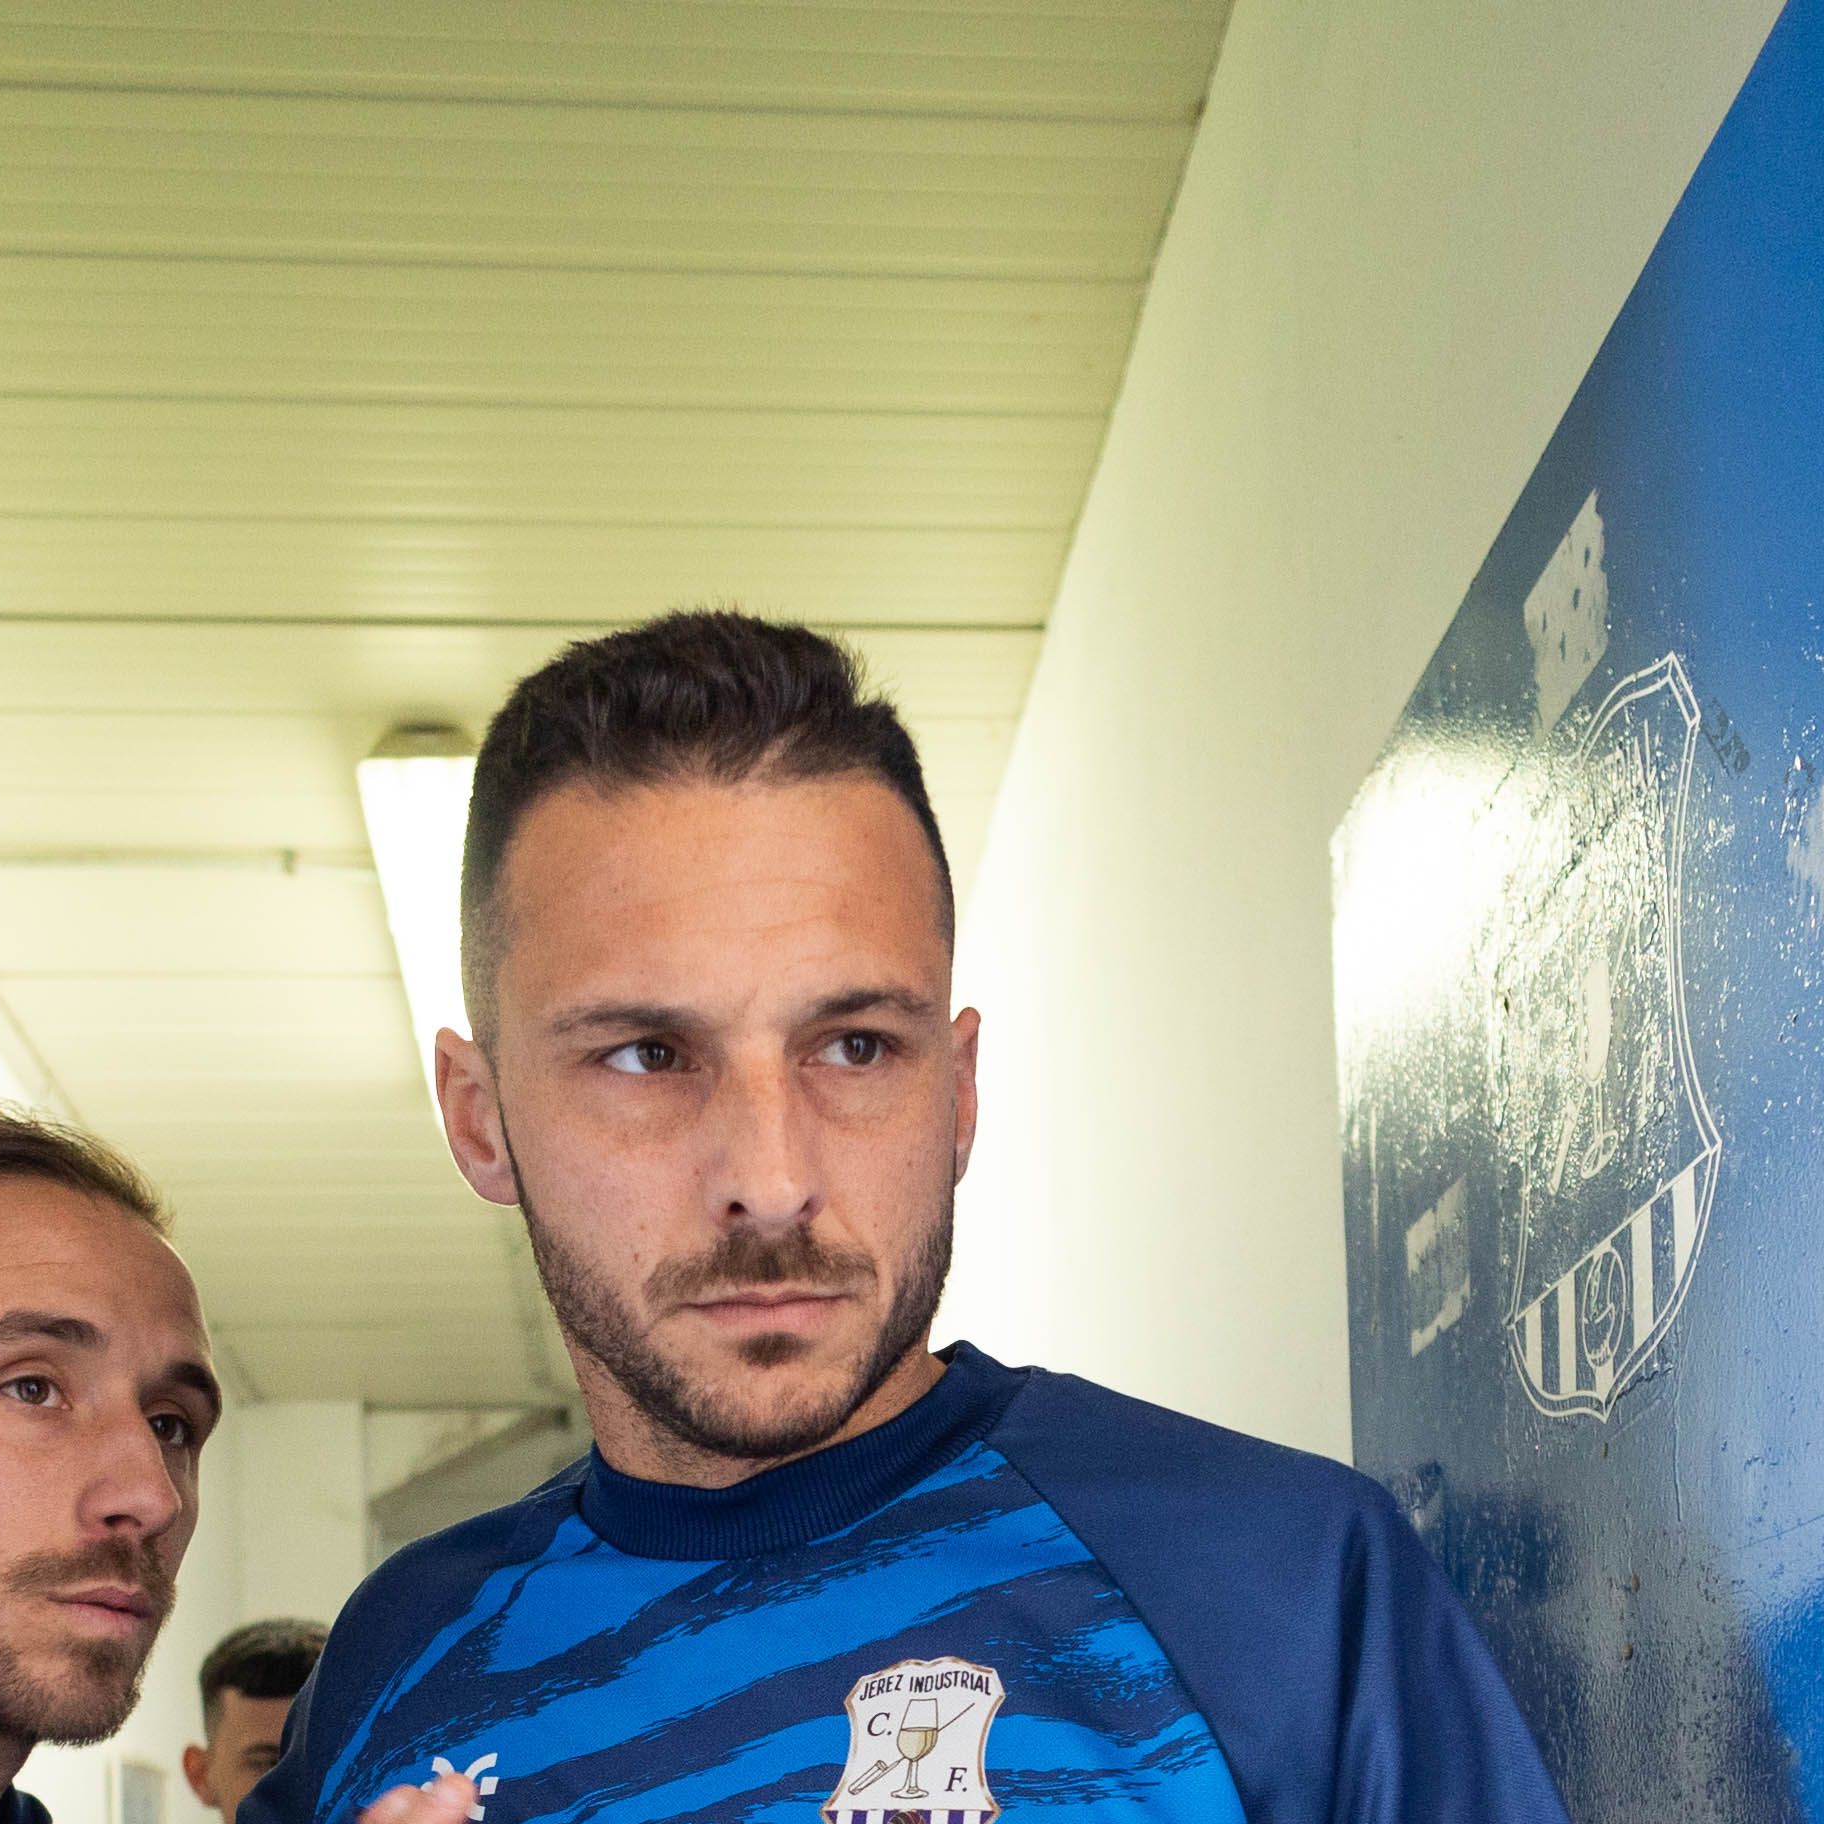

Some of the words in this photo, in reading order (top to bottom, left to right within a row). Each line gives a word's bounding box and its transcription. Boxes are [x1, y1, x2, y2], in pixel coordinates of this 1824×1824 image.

[859, 1673, 904, 1701] JEREZ
[909, 1670, 992, 1696] INDUSTRIAL
[866, 1711, 893, 1737] C.
[944, 1766, 968, 1793] F.
